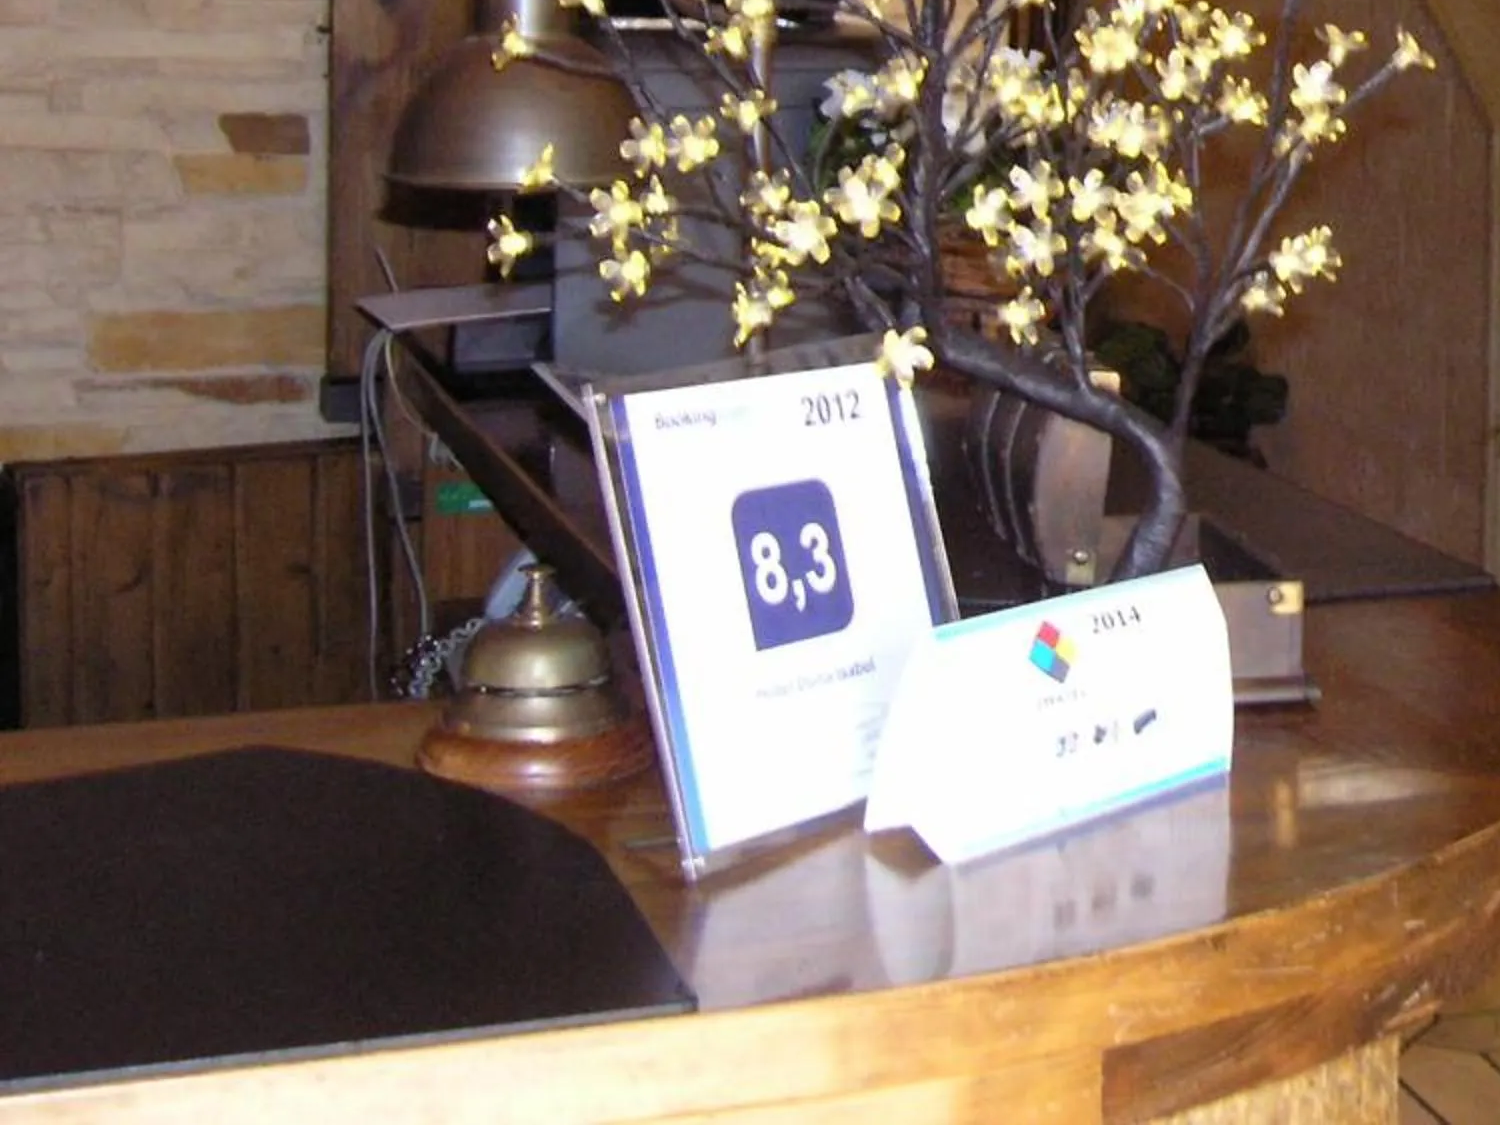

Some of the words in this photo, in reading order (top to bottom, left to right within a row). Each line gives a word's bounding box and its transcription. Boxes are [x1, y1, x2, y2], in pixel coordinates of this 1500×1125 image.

[801, 389, 862, 427] 2012
[751, 521, 837, 612] 8,3
[1088, 605, 1142, 635] 2014
